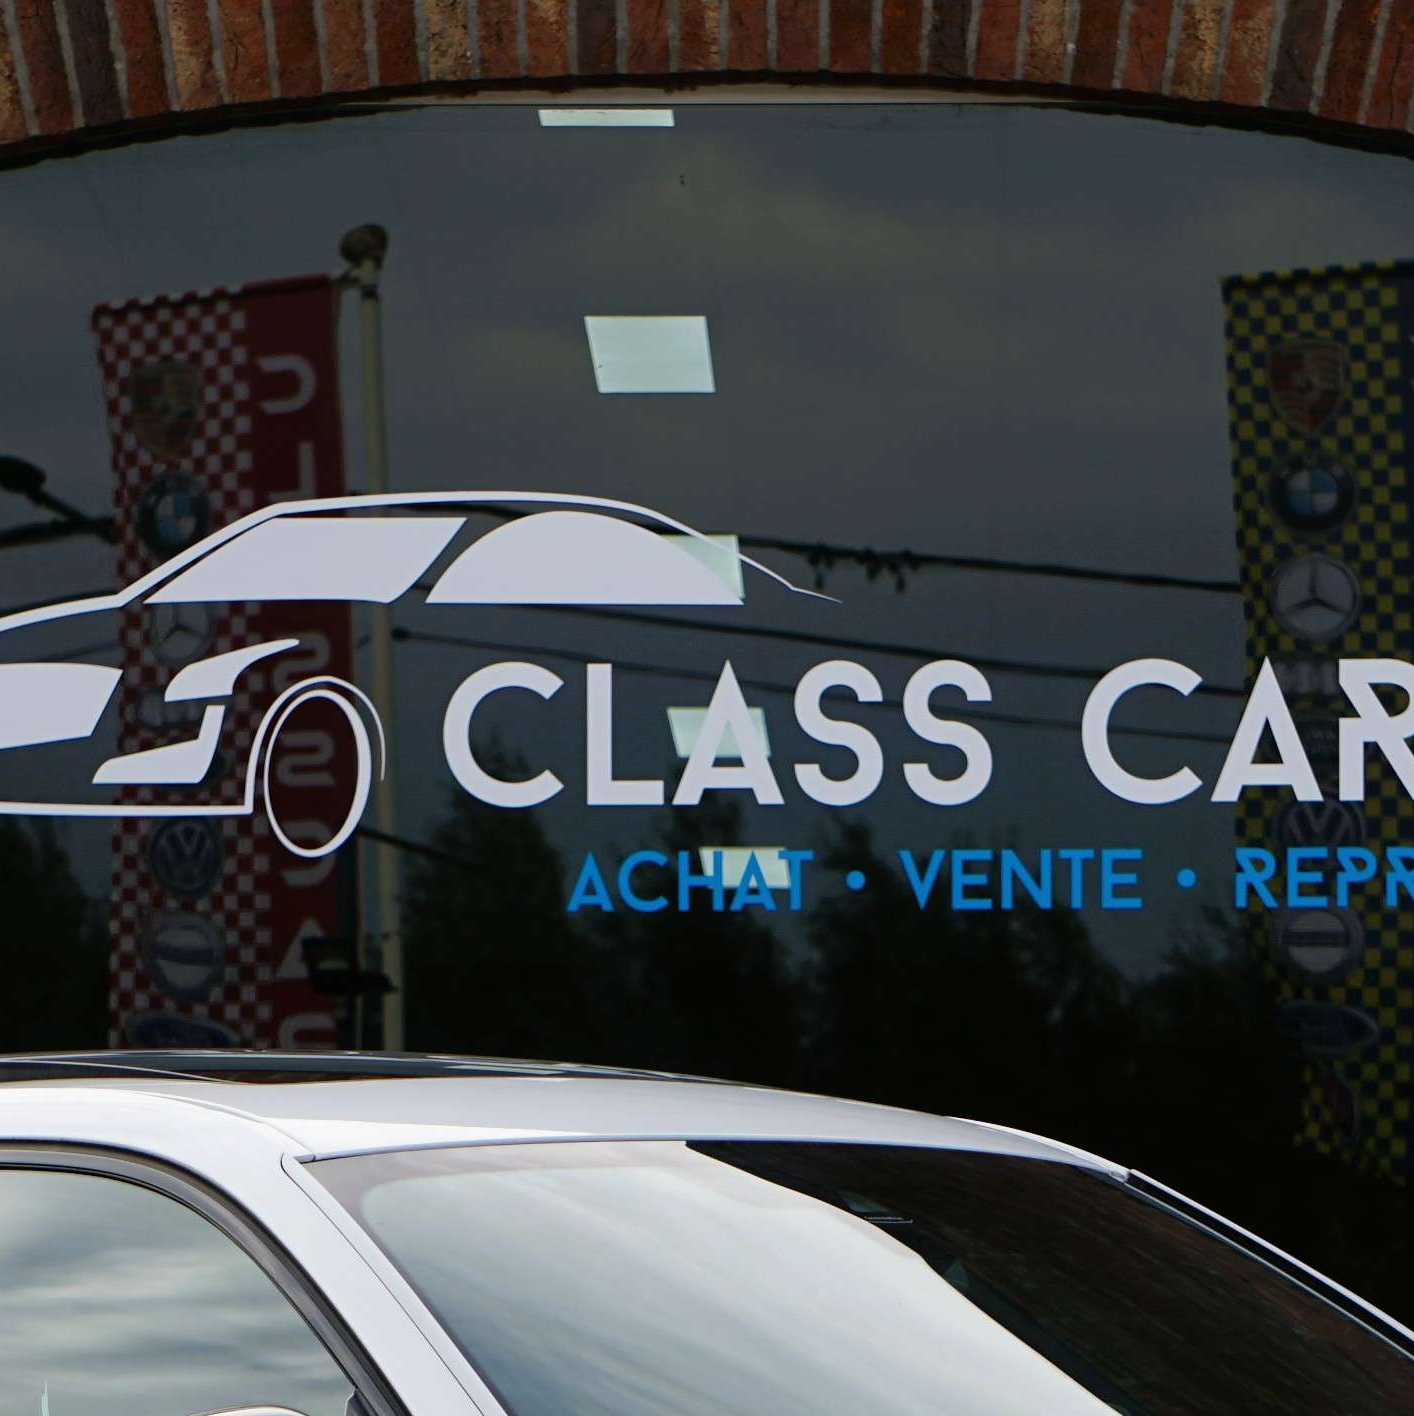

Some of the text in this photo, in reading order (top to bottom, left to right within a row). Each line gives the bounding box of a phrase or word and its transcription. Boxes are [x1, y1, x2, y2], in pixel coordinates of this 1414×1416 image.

[443, 660, 992, 807] CLASS
[567, 849, 814, 913] ACHAT
[900, 848, 1142, 910] VENTE
